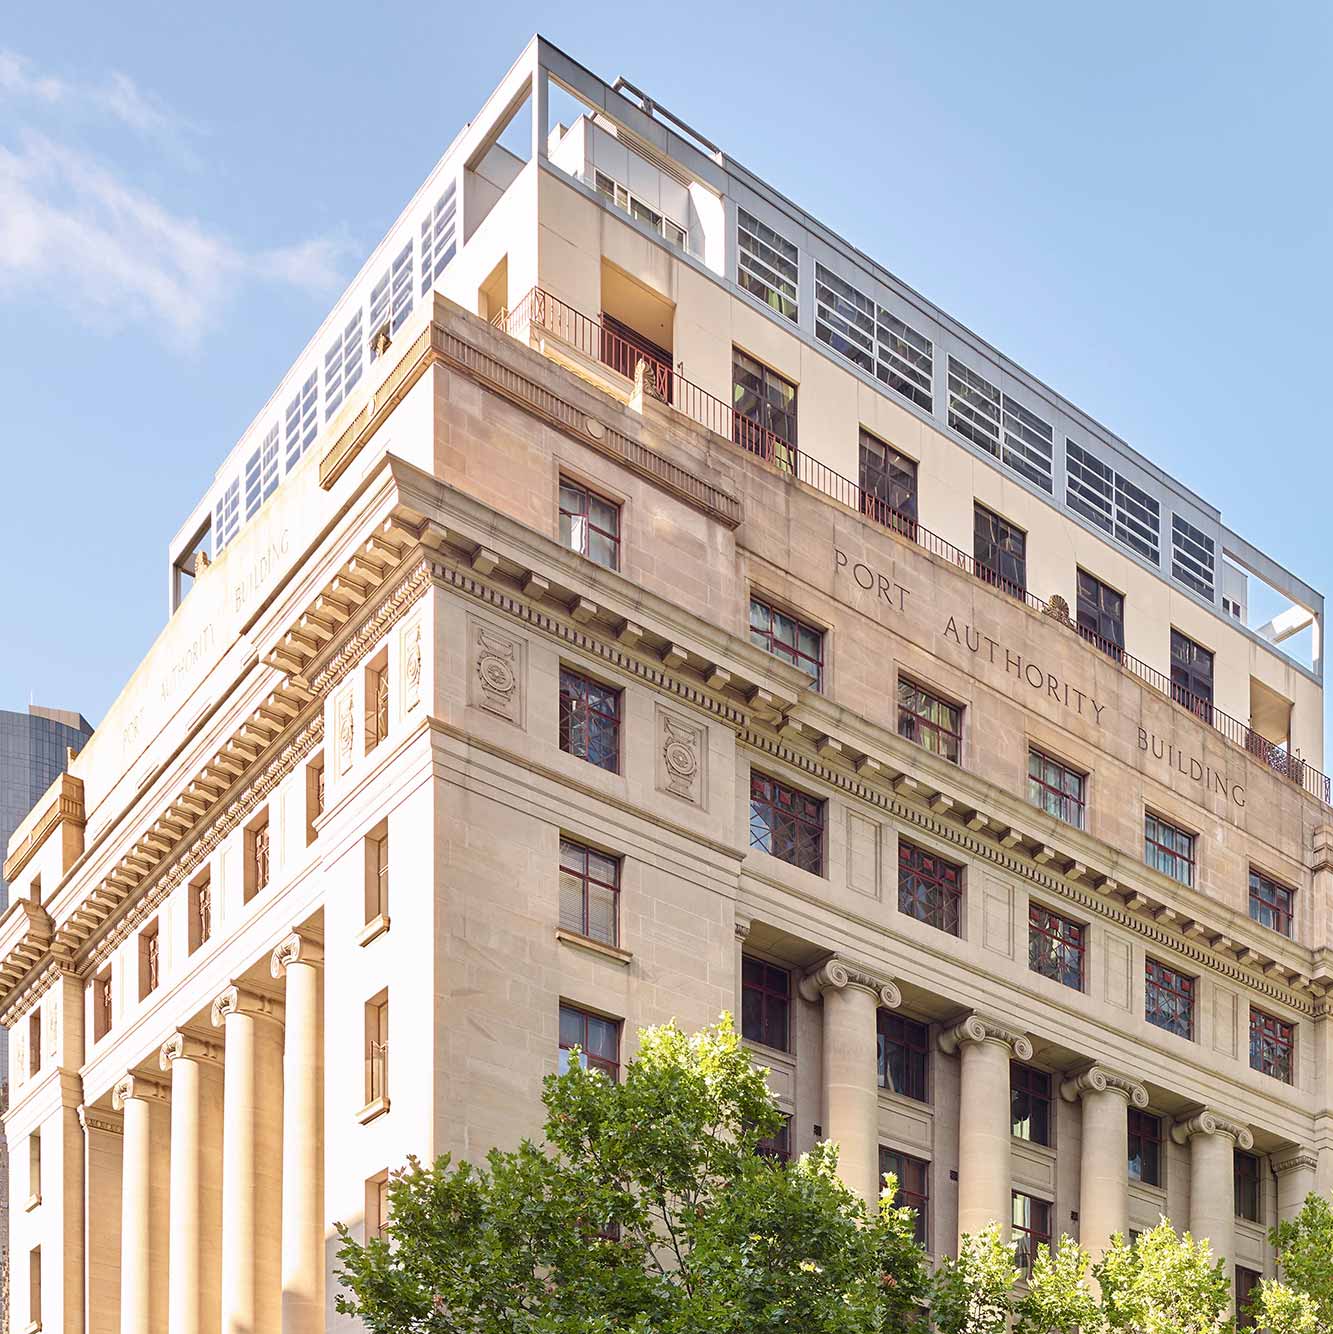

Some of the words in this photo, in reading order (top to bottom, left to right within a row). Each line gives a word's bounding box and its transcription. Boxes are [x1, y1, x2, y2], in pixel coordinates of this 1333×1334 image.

[233, 528, 290, 614] BUILDING
[834, 548, 911, 612] PORT
[943, 615, 1105, 725] AUTHORITY
[1137, 726, 1246, 808] BUILDING
